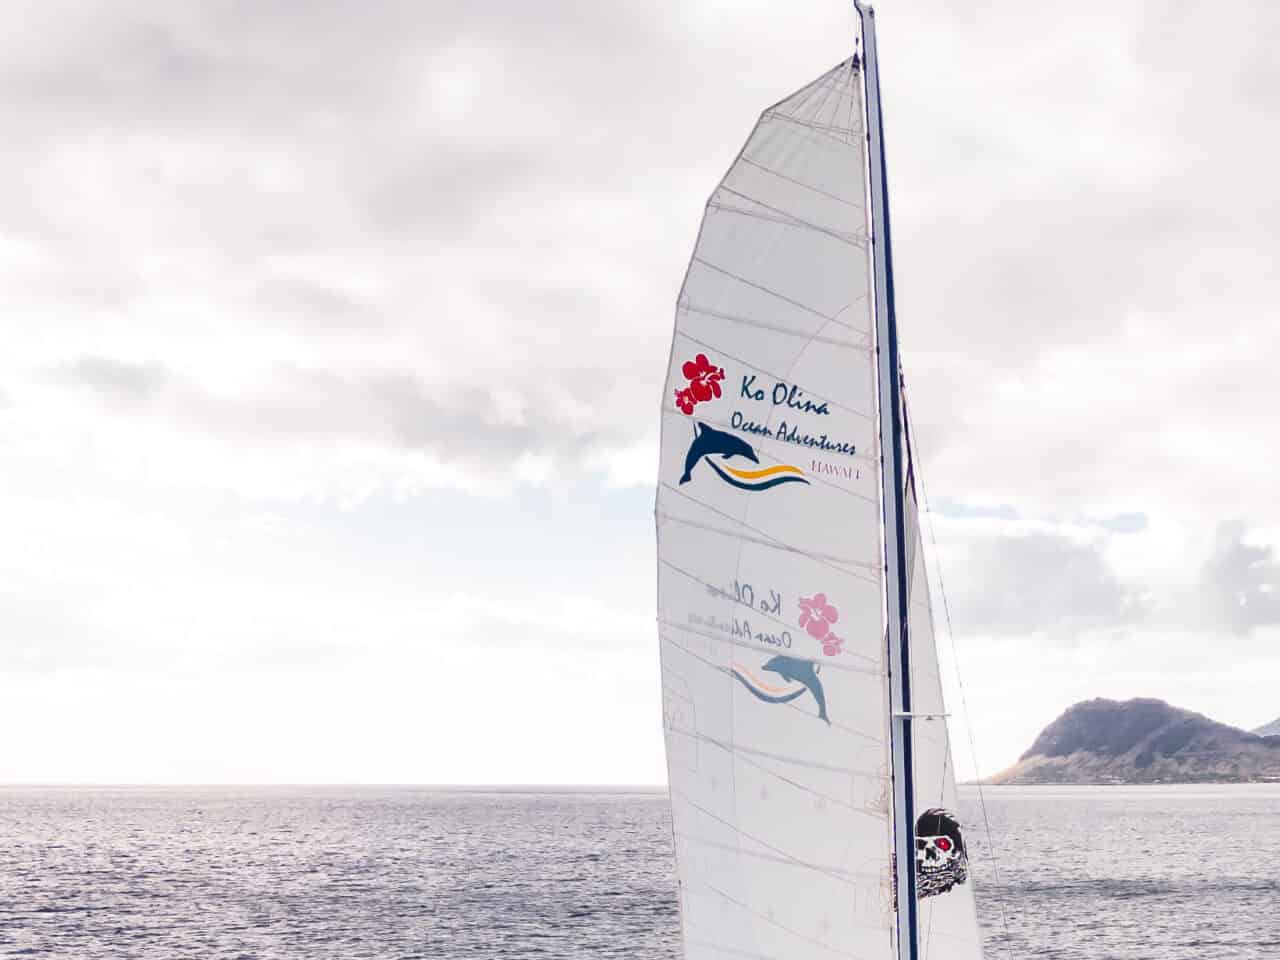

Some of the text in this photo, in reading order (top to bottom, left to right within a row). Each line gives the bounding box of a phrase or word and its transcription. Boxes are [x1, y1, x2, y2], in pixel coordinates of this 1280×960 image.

[741, 376, 830, 415] Ko Olina
[731, 412, 856, 456] Ocean Adventures
